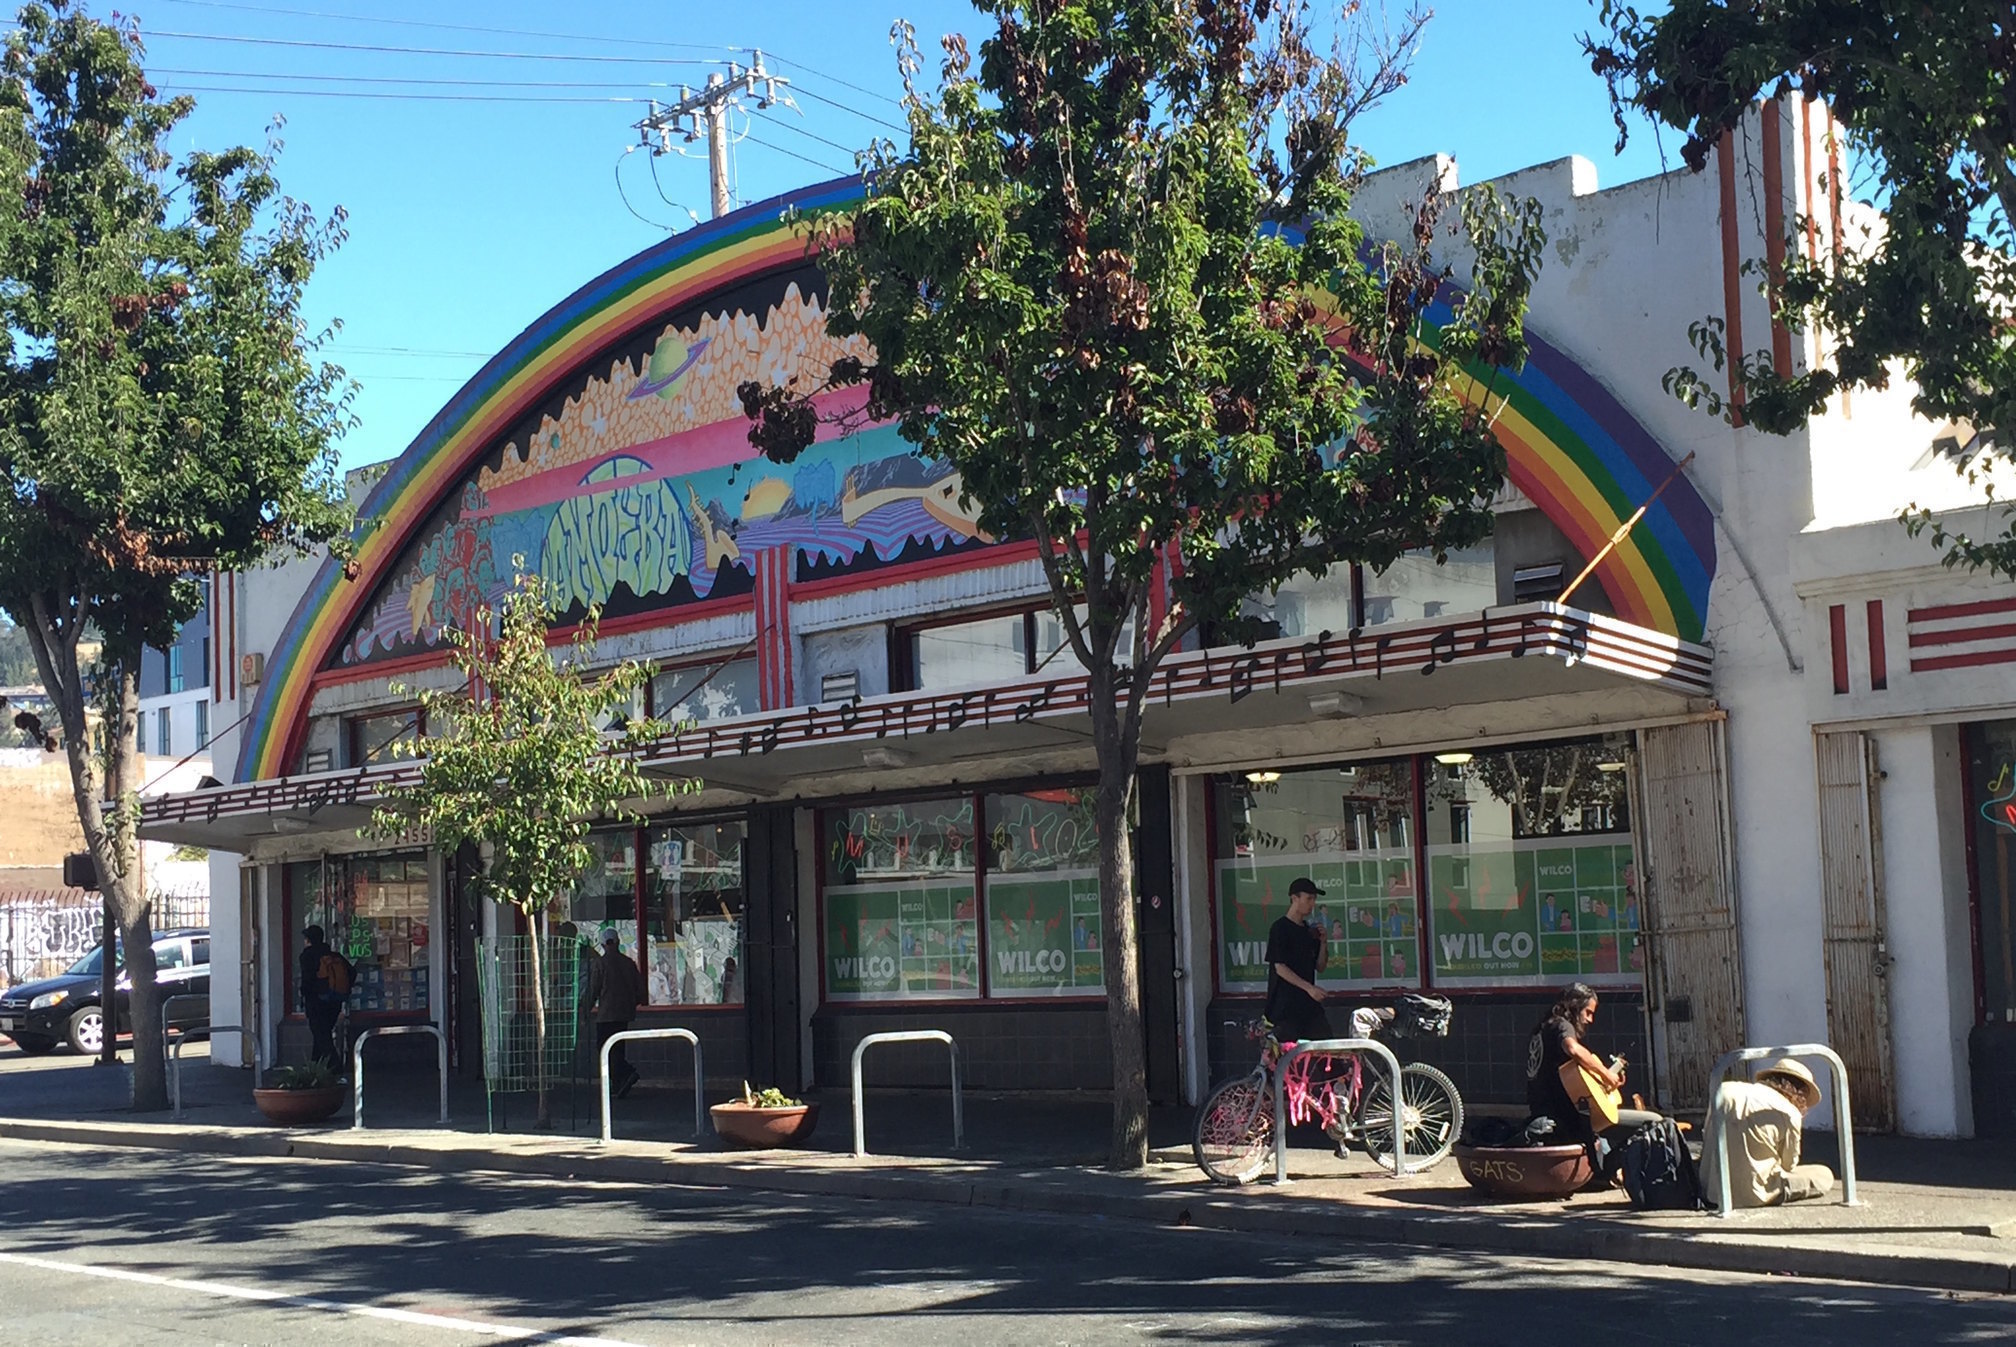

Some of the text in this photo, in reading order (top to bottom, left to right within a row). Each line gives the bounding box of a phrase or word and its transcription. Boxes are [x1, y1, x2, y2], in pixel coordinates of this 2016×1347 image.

[541, 456, 692, 613] AMOEBA
[1539, 864, 1573, 876] WILCO
[901, 902, 923, 913] WILCO
[1073, 893, 1098, 902] WILCO
[1227, 941, 1270, 966] WIL
[1439, 931, 1534, 961] WILCO
[834, 956, 896, 979] WILCO
[997, 949, 1067, 974] WILCO
[1483, 962, 1499, 970] OUT
[1500, 961, 1520, 969] NOW
